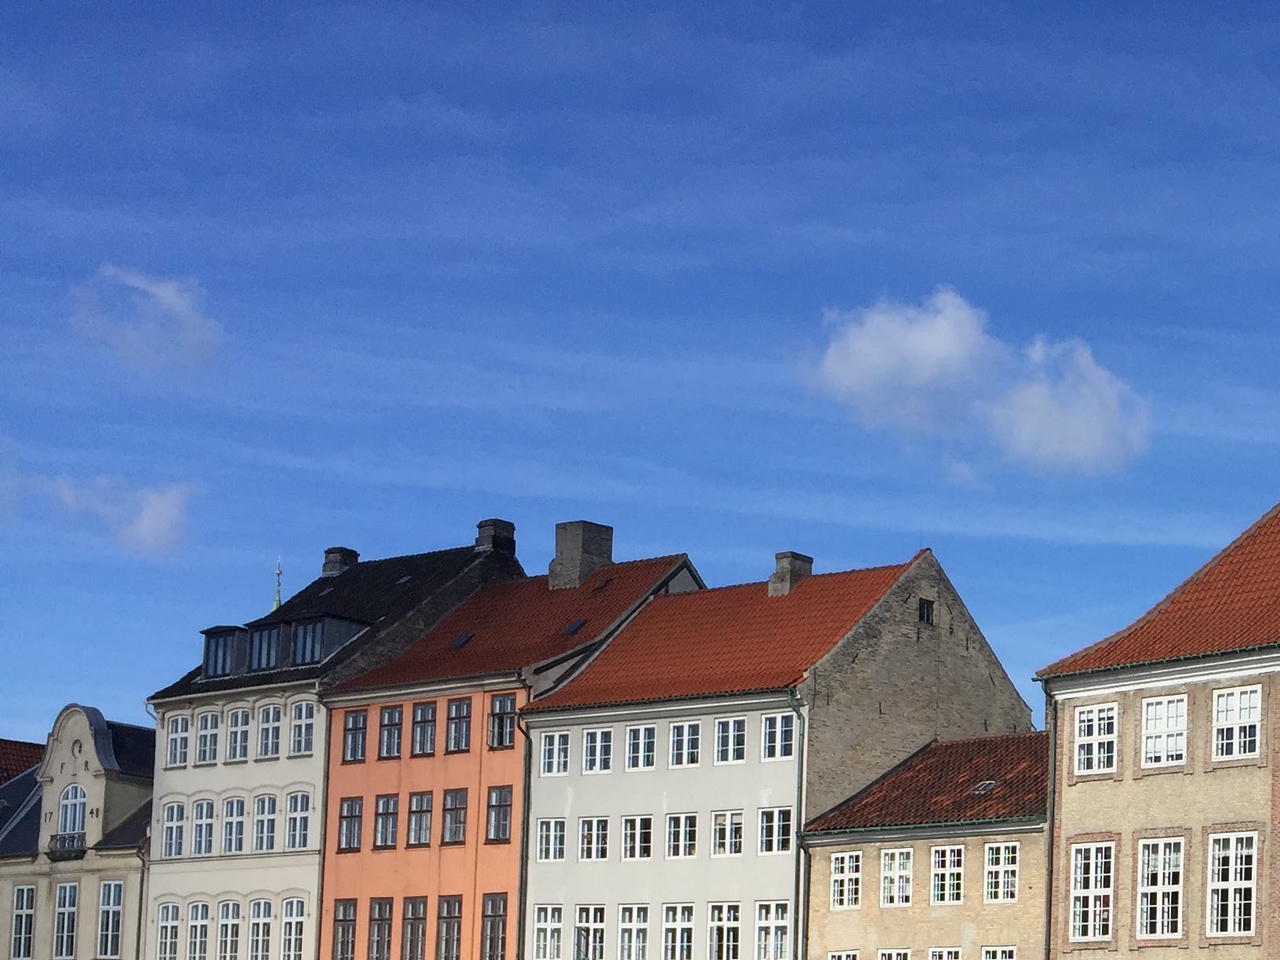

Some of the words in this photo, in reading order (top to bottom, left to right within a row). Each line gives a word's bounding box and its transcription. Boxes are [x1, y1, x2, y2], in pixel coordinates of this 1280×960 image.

[84, 760, 90, 772] R
[44, 811, 53, 823] 17
[89, 807, 100, 819] 48
